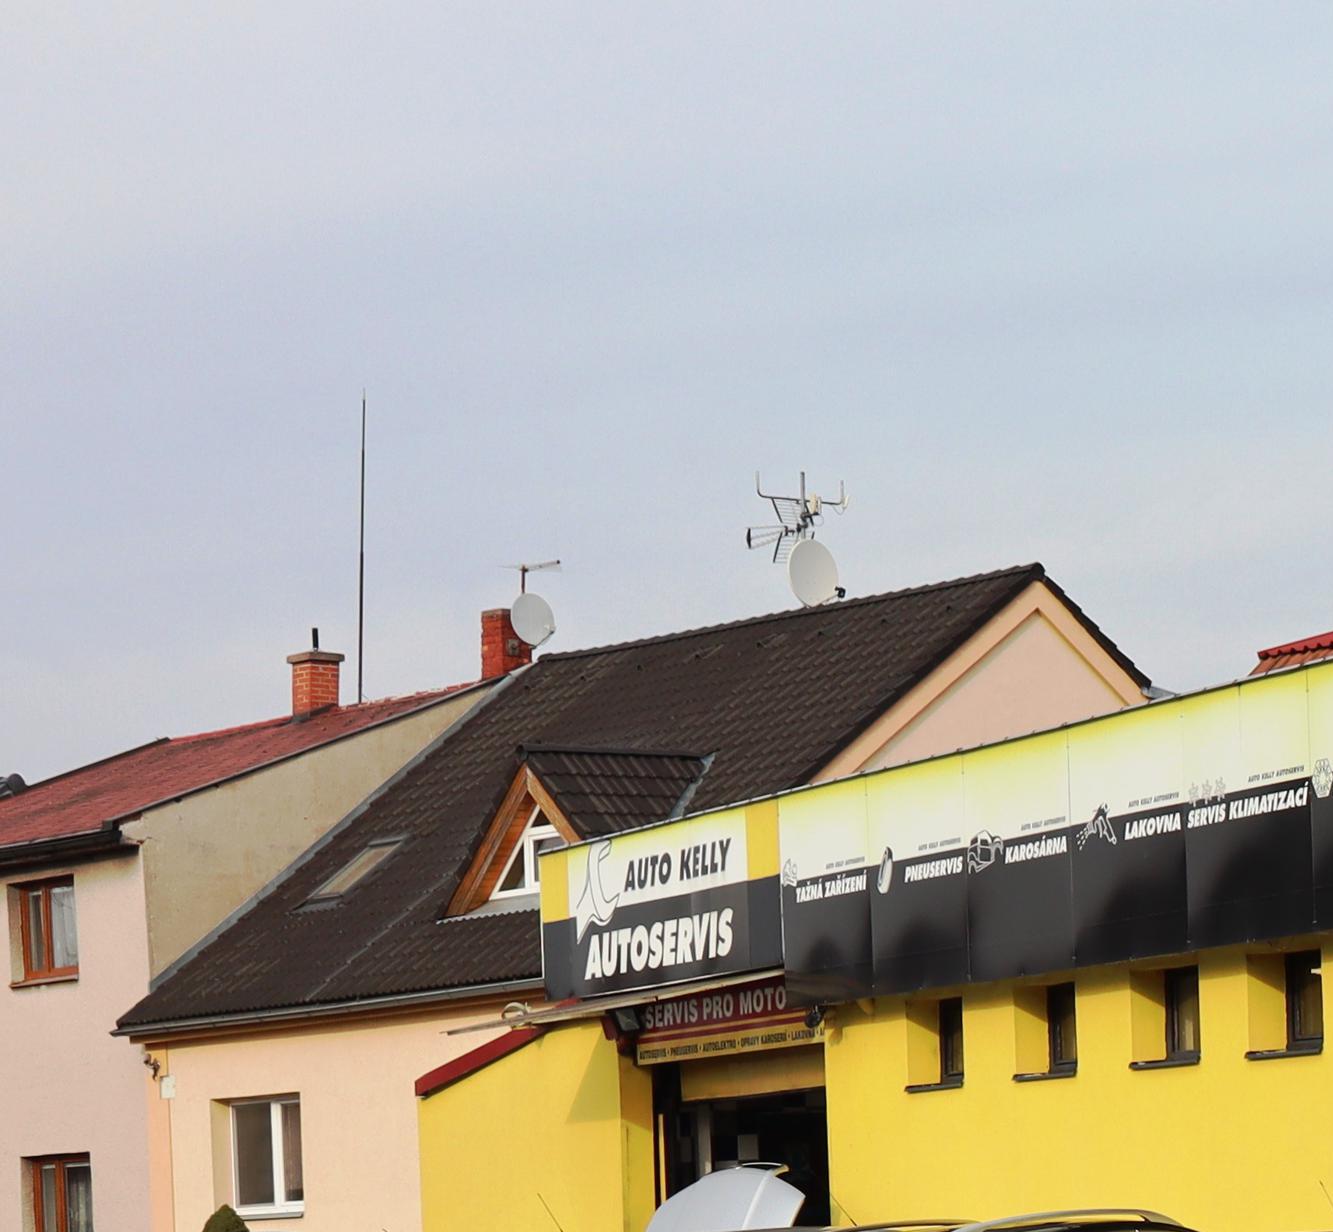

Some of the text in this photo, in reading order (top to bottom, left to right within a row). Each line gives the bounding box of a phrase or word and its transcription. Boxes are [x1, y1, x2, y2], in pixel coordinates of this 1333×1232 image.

[1187, 781, 1309, 829] SERVIS KLIMATIZACÍ
[1124, 812, 1181, 840] LAKOVNA
[624, 838, 732, 892] AUTO KELLY
[1005, 834, 1067, 864] KAROSÁRNA
[796, 870, 867, 903] TAŽNÁ ZAŘÍZENÍ
[904, 856, 963, 883] PNEUSERVIS
[584, 908, 734, 980] AUTOSERVIS
[645, 986, 786, 1029] SERVIS PRO MOTO
